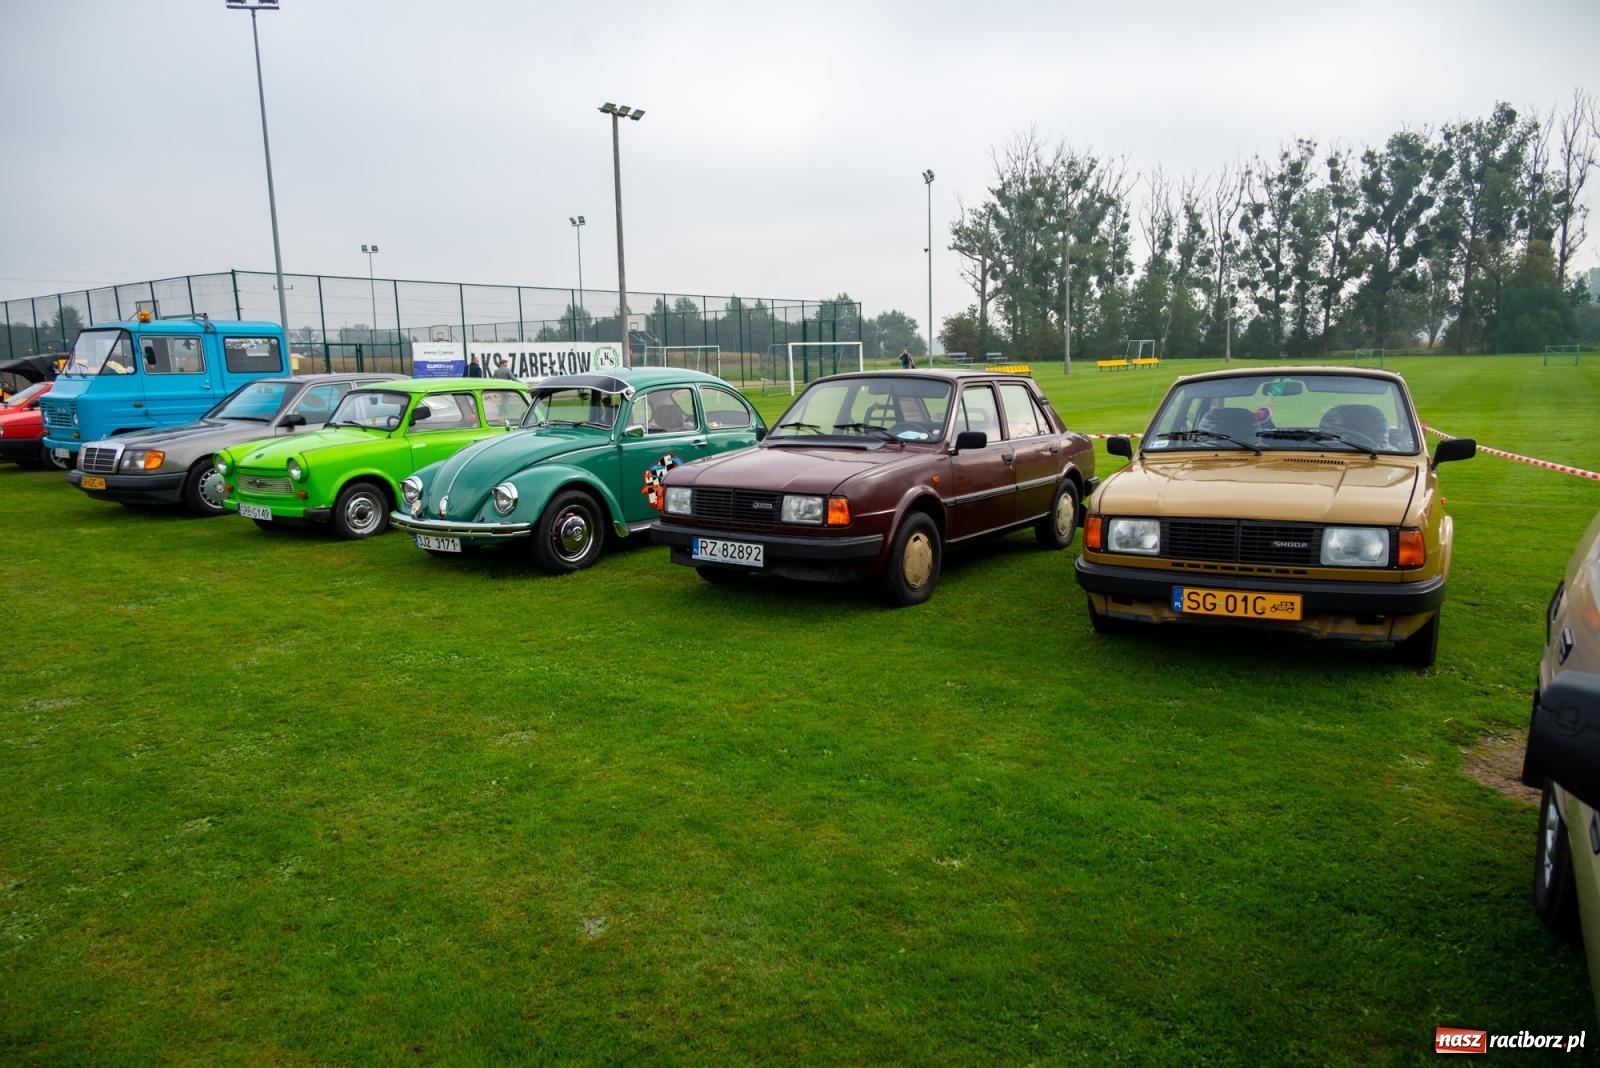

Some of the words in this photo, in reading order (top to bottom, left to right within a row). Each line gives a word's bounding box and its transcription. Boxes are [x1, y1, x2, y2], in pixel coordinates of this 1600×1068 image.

[700, 540, 718, 556] RZ
[721, 542, 762, 562] 82892
[1187, 591, 1217, 612] SG
